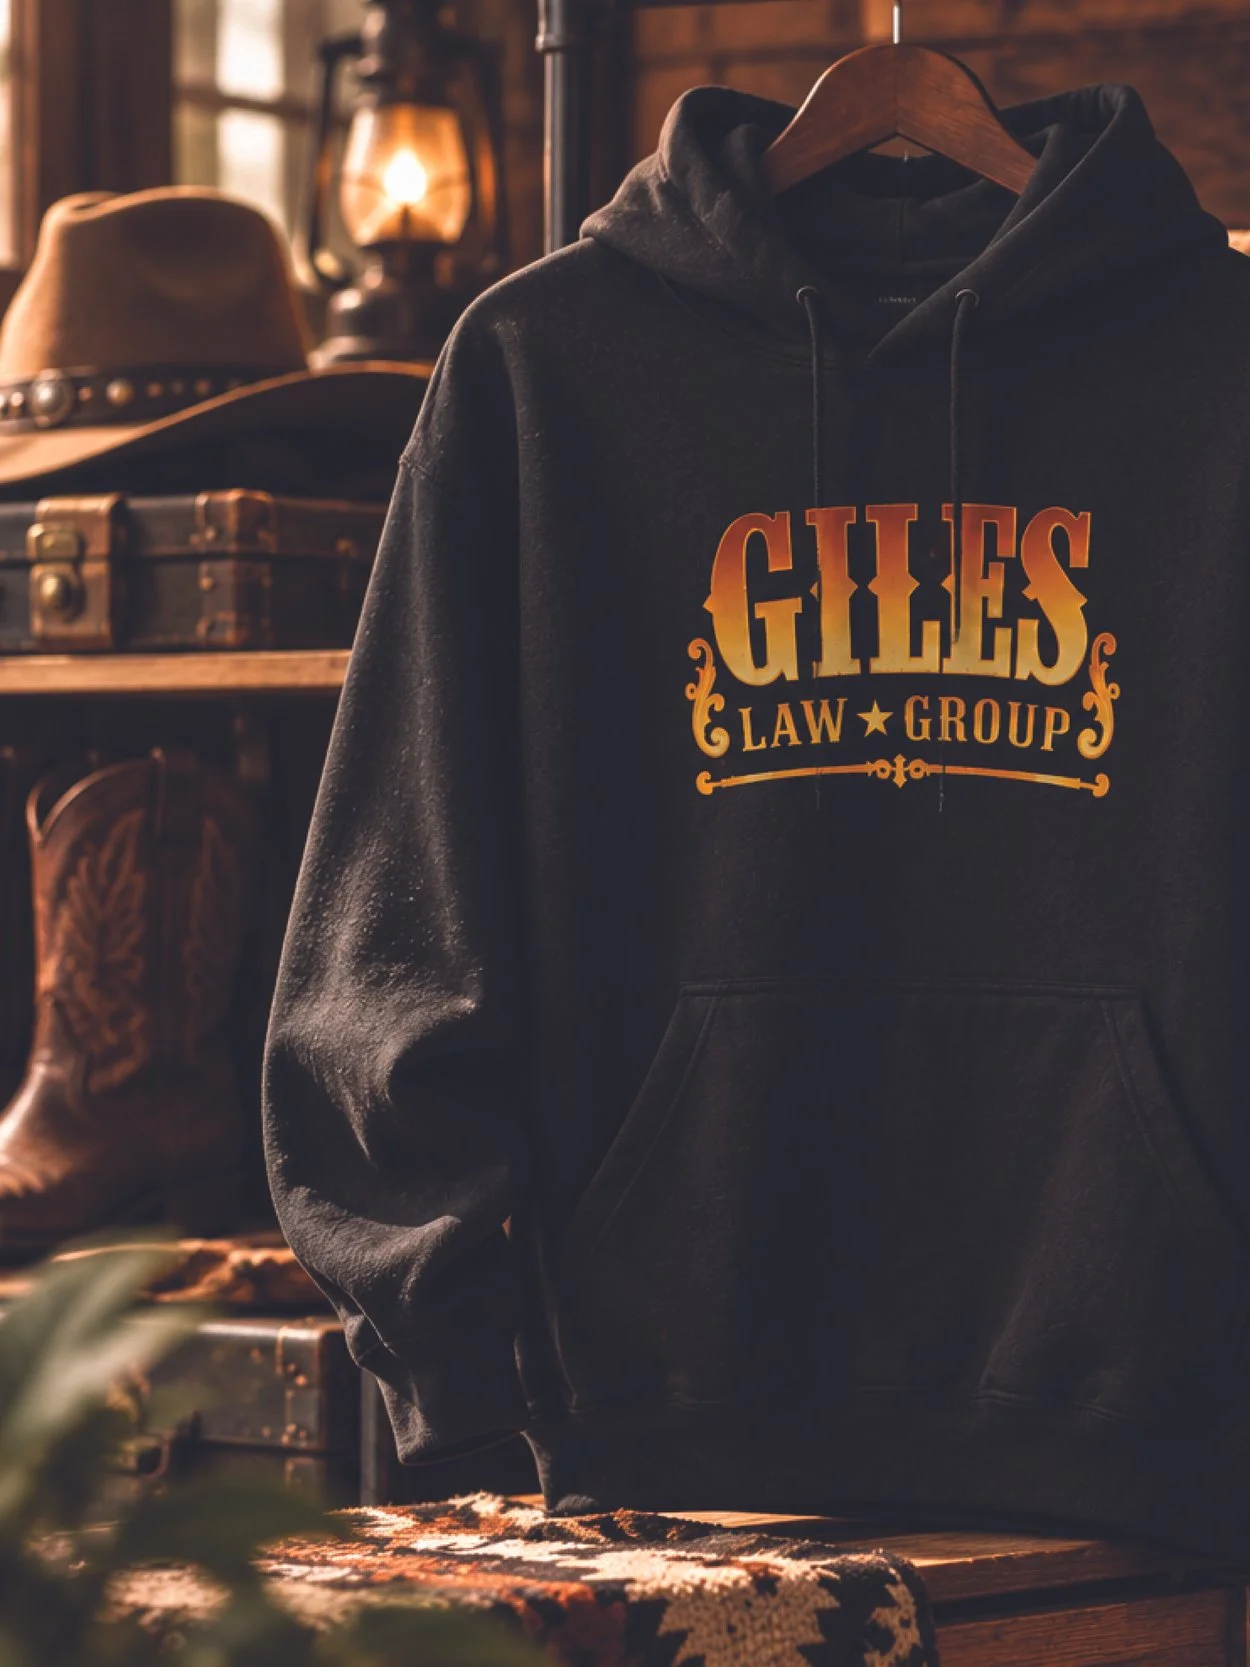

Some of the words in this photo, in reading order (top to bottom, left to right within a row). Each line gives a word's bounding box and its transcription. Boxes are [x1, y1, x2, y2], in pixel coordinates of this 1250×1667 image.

[702, 503, 1091, 686] GILES
[738, 698, 848, 752] LAW
[904, 695, 1071, 752] GROUP
